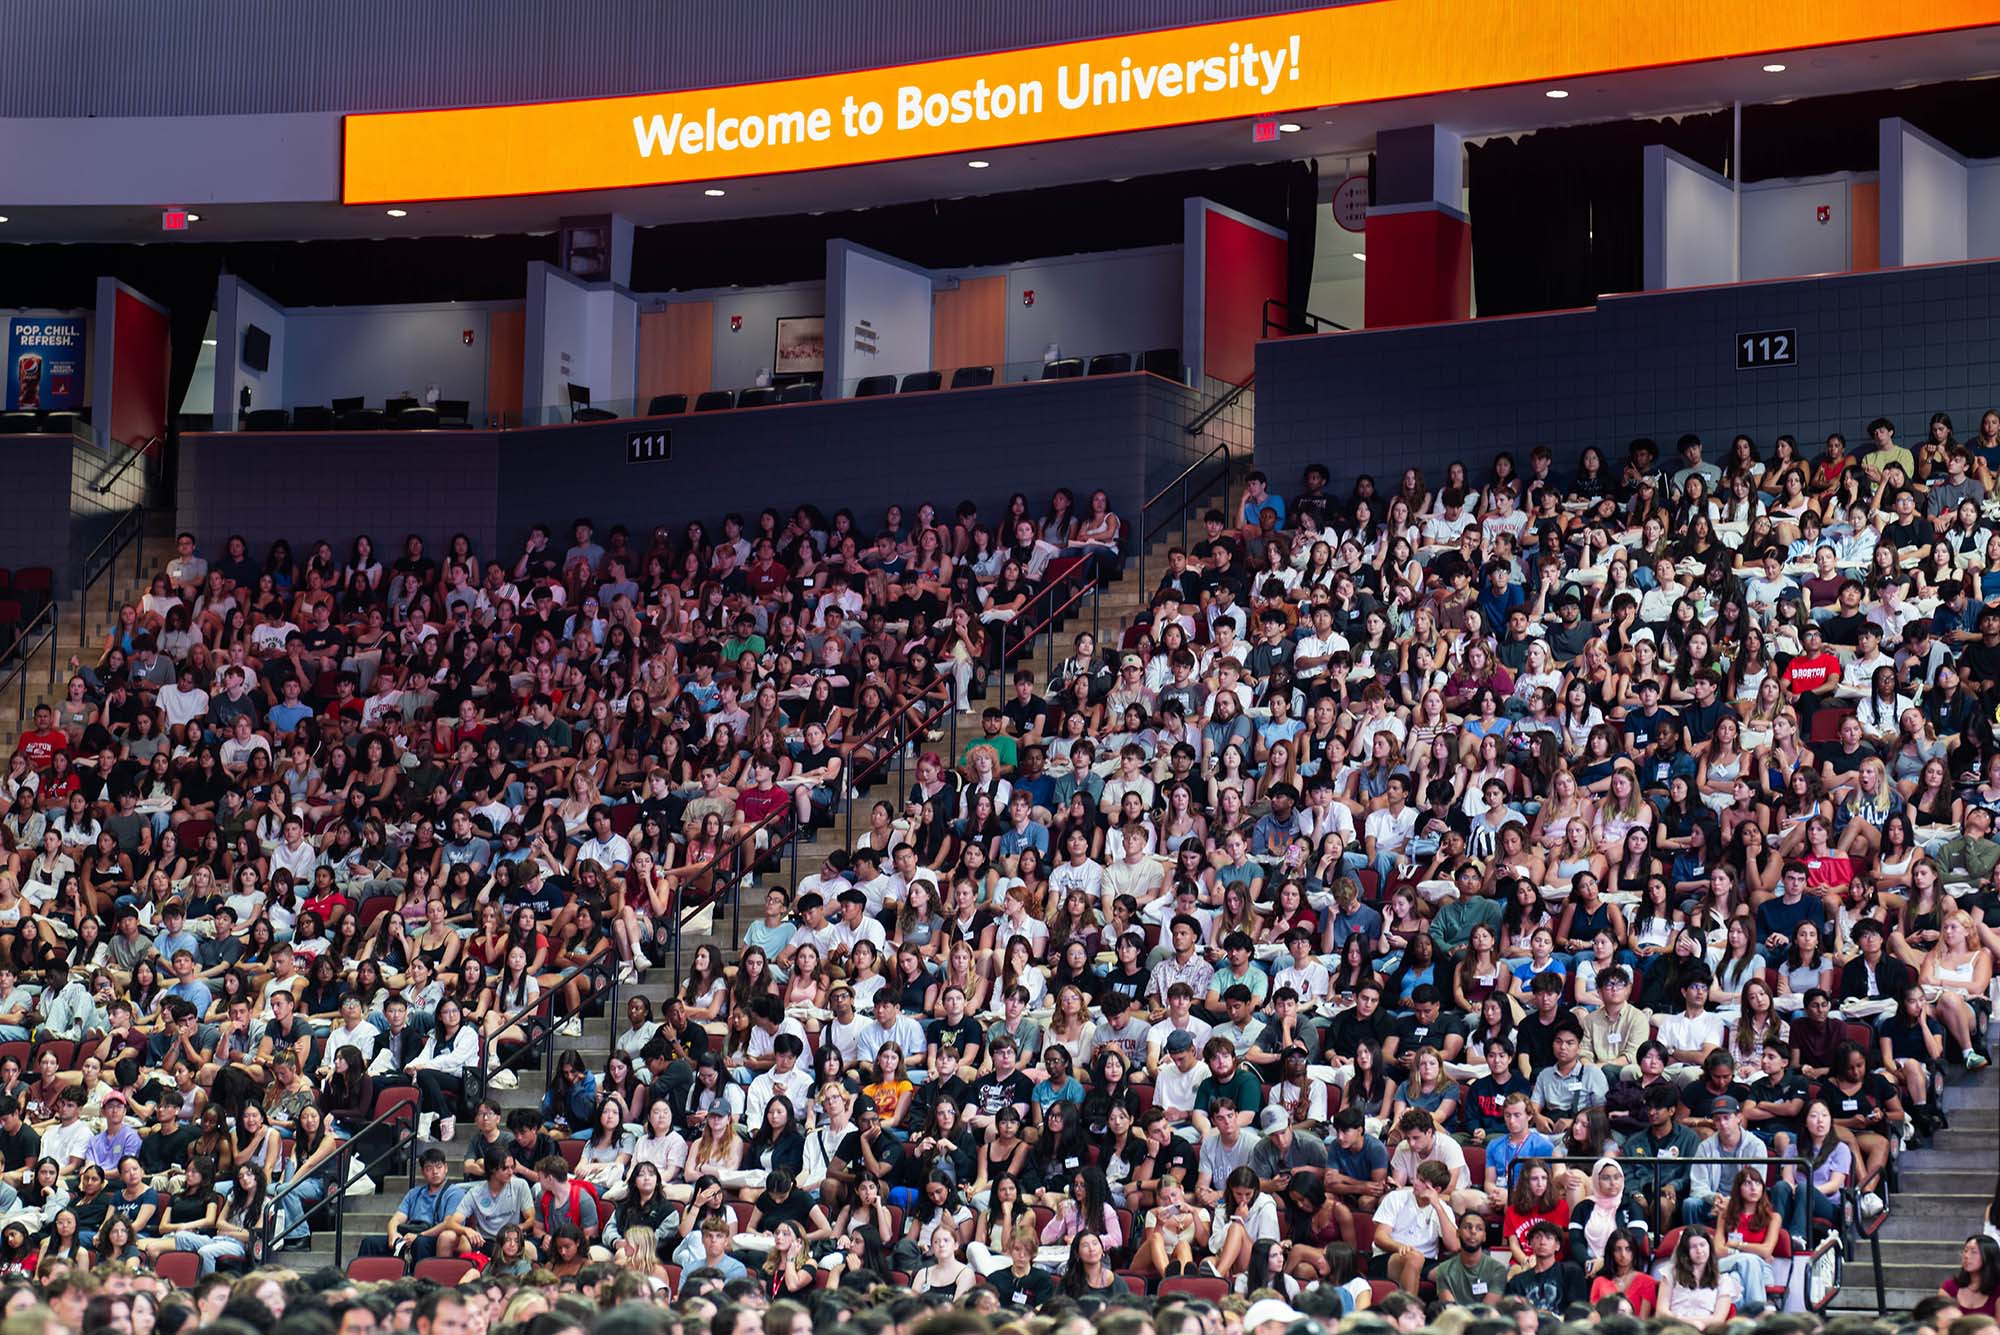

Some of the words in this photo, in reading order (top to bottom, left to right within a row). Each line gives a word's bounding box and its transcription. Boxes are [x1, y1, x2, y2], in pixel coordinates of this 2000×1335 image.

[633, 108, 831, 157] Welcome
[842, 96, 884, 136] to
[898, 79, 1043, 129] Boston
[1058, 35, 1300, 109] University!
[15, 325, 42, 336] POP.
[44, 325, 80, 336] CHILL.
[20, 336, 74, 346] REFRESH.
[1743, 335, 1789, 362] 112
[632, 435, 665, 458] 111
